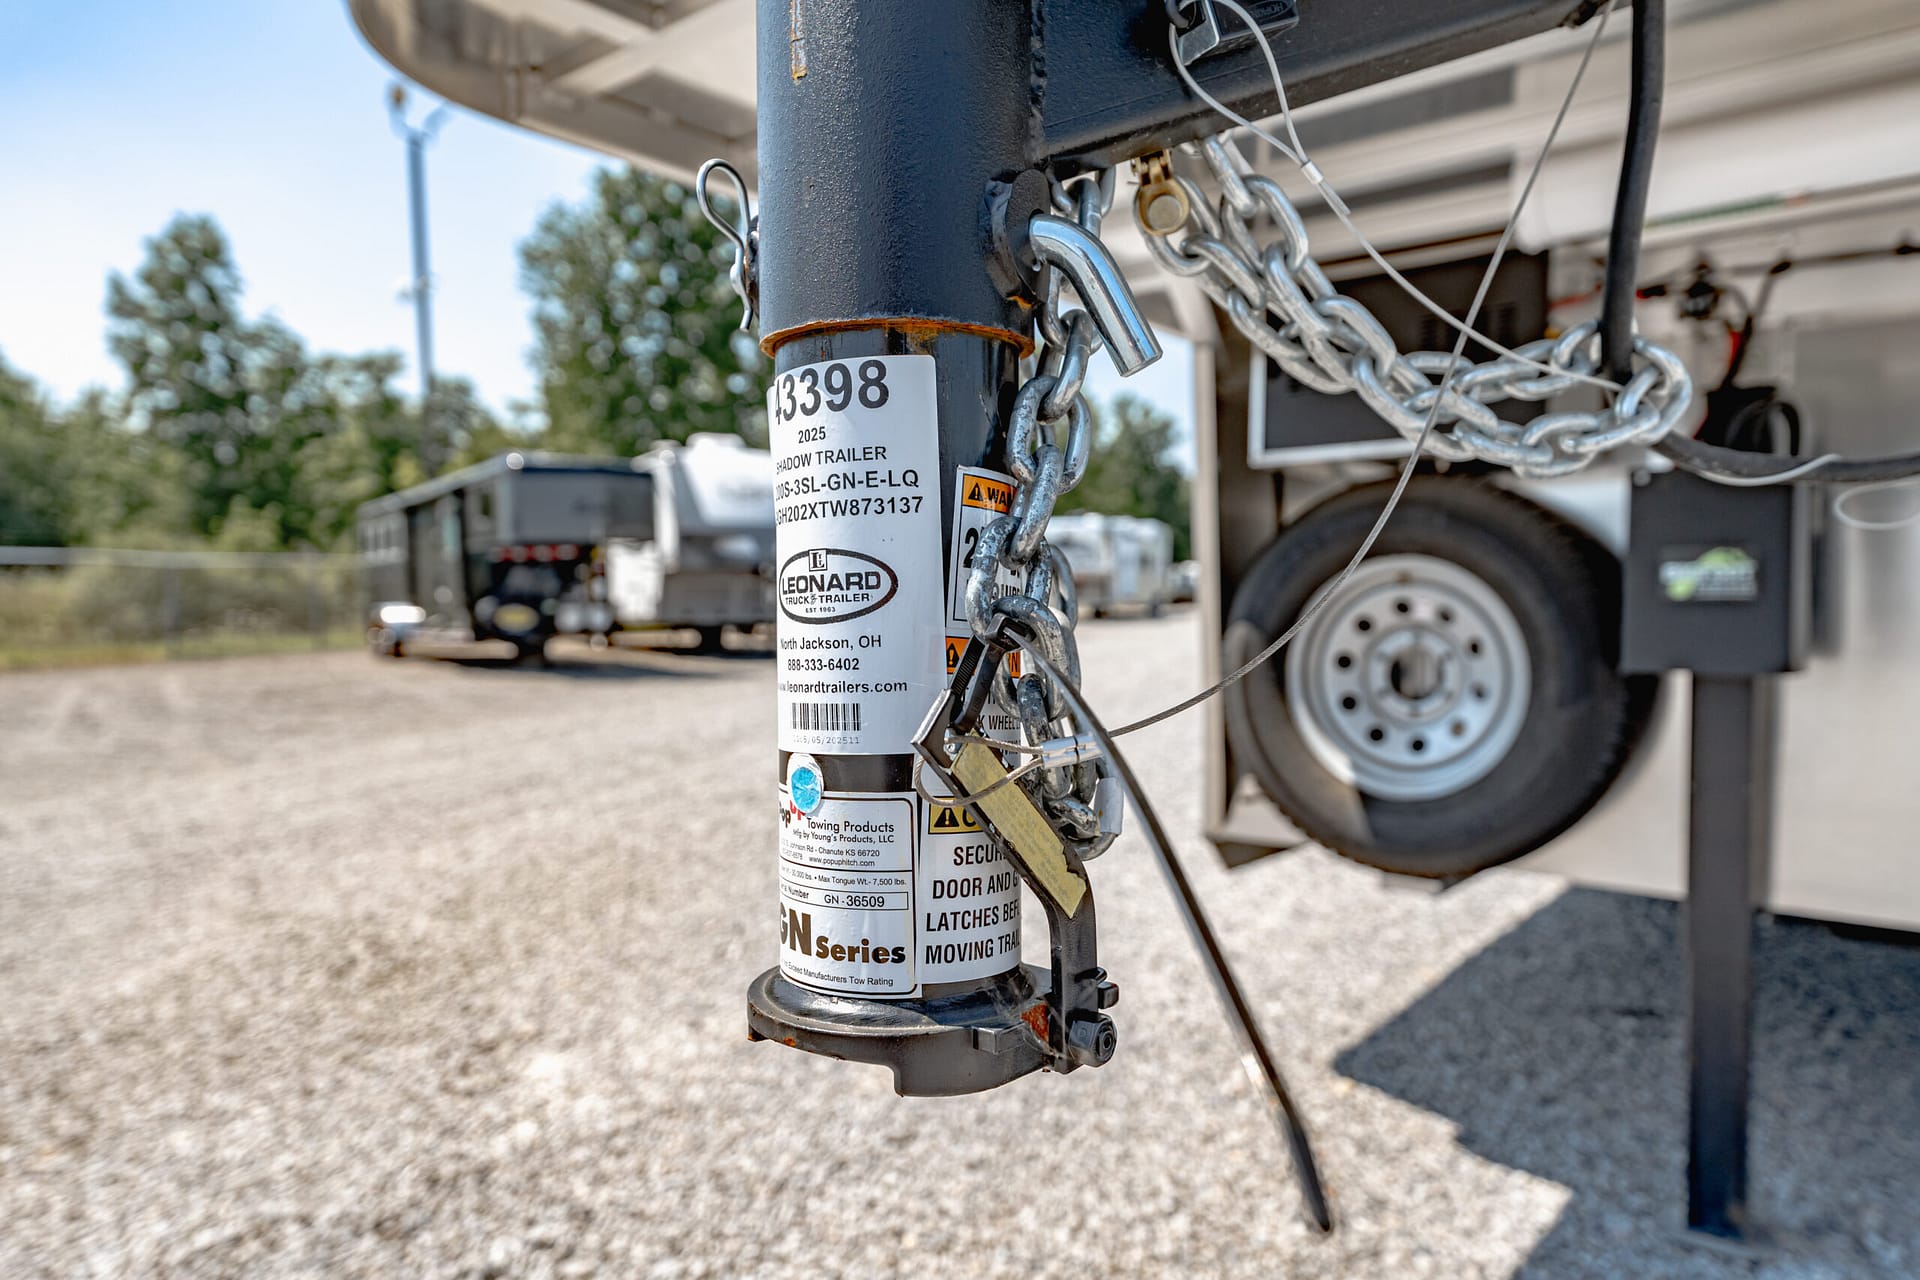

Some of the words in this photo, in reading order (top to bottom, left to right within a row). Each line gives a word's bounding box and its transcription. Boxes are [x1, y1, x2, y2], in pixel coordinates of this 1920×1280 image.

[775, 360, 889, 425] 43398
[798, 426, 826, 444] 2025
[815, 446, 887, 465] TRAILER
[782, 571, 881, 595] LEONARD
[785, 595, 809, 605] TRUCK
[818, 593, 870, 604] TRAILER
[780, 637, 798, 650] North
[800, 636, 854, 651] Jackson,
[858, 635, 882, 648] OH
[788, 658, 860, 671] 888-333-6402
[806, 817, 840, 834] Towing
[843, 820, 895, 833] Products
[803, 830, 811, 840] by
[811, 831, 838, 843] Young's
[839, 834, 876, 844] Products,
[878, 835, 895, 843] LLC
[818, 847, 844, 856] Chanute
[845, 849, 856, 857] KS
[953, 844, 1007, 866] SECUR
[832, 876, 856, 886] Tongue
[872, 878, 893, 886] 7,500
[932, 876, 982, 900] DOOR
[987, 871, 1010, 895] AND
[926, 907, 999, 932] LATCHES
[815, 935, 907, 964] Series
[925, 938, 994, 965] MOVING
[803, 967, 848, 983] Manufacturers
[849, 976, 865, 985] Tow
[867, 978, 894, 987] Rating
